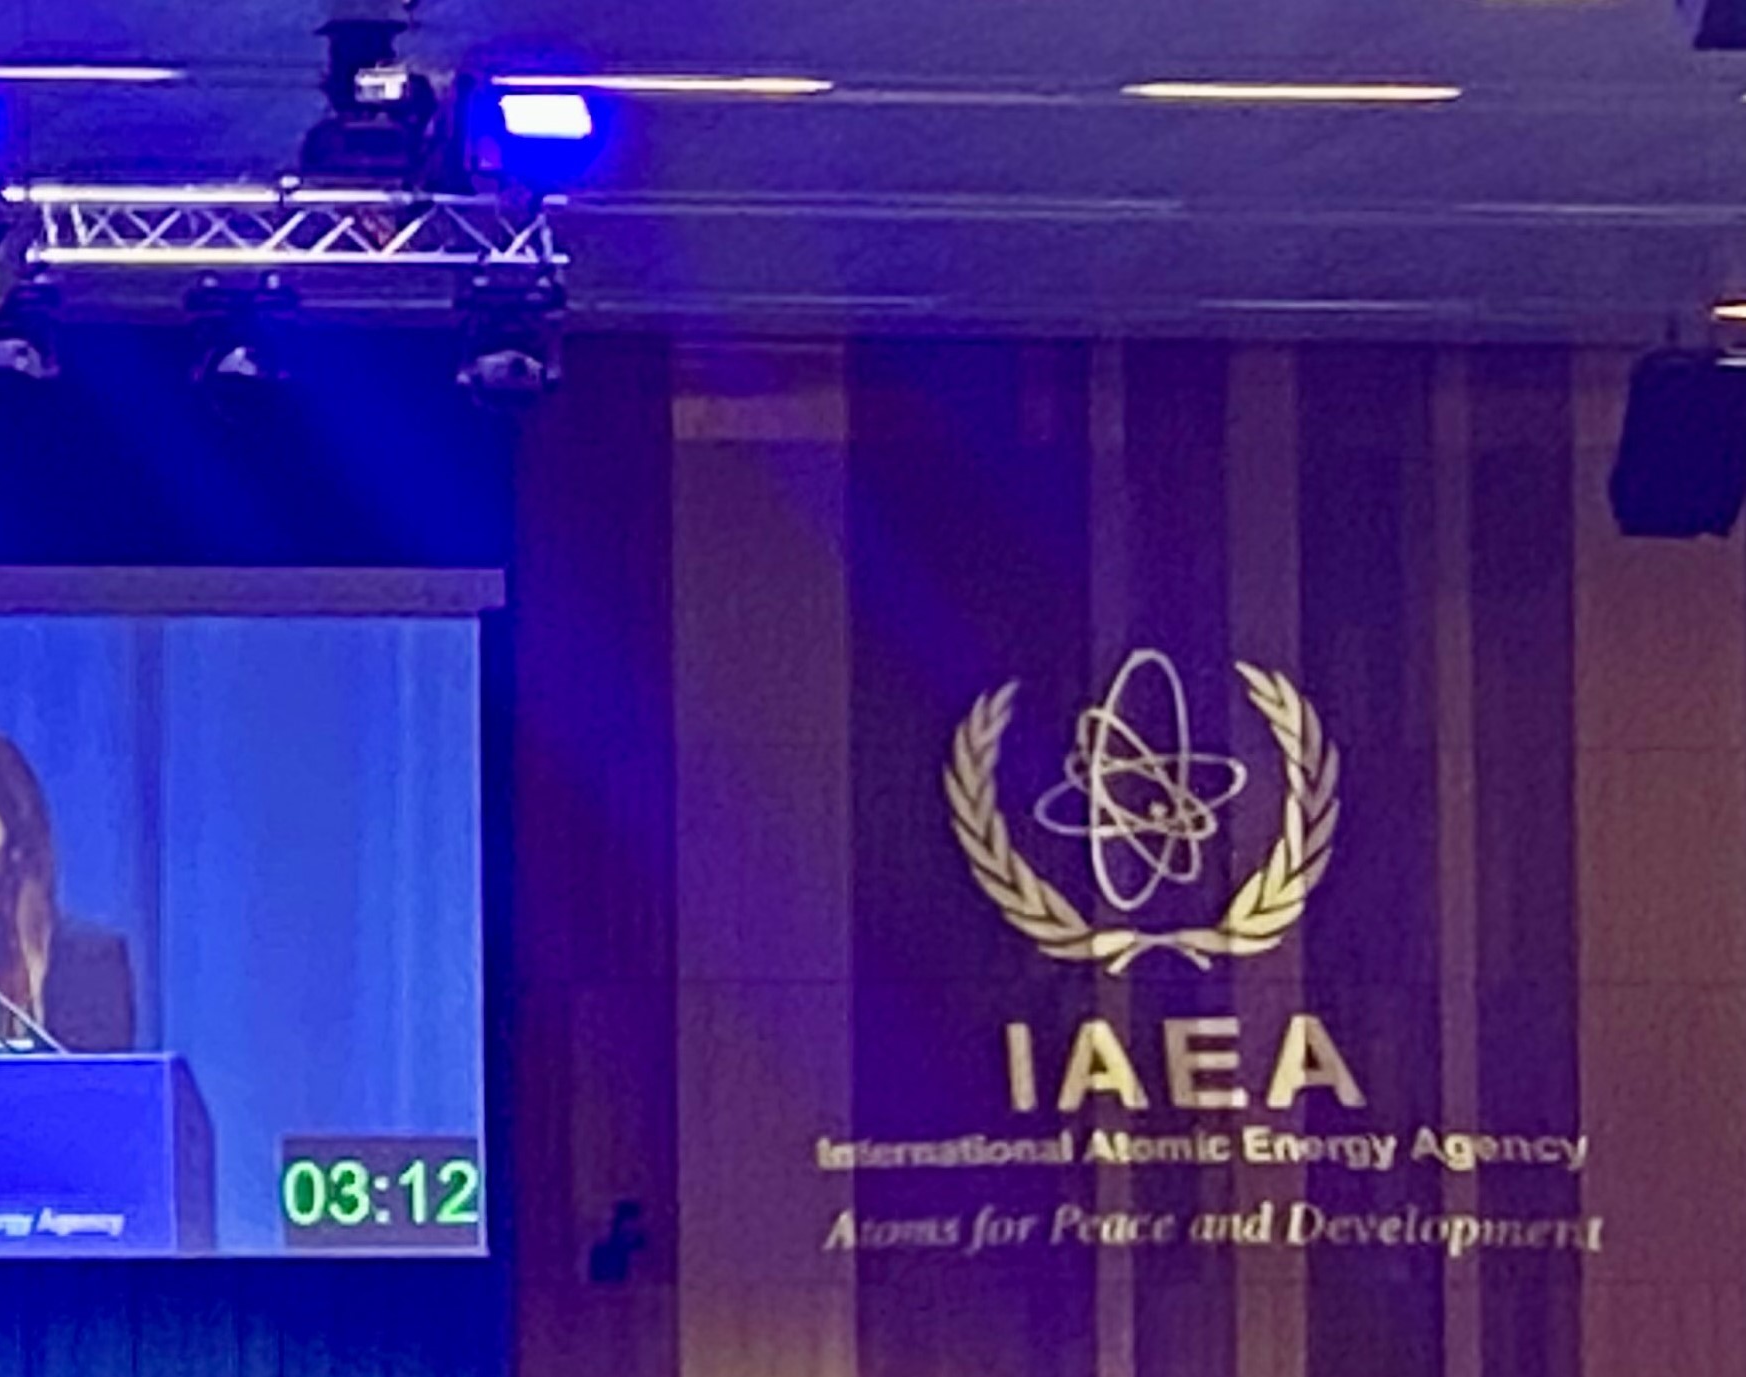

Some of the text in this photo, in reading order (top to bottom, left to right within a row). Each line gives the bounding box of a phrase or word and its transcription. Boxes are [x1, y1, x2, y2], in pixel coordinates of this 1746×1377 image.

[1006, 1014, 1367, 1112] IAEA
[816, 1125, 1589, 1171] International Atomic Energy Agency
[284, 1159, 479, 1225] 03:12
[822, 1200, 1605, 1258] Atoms for Peace and Development
